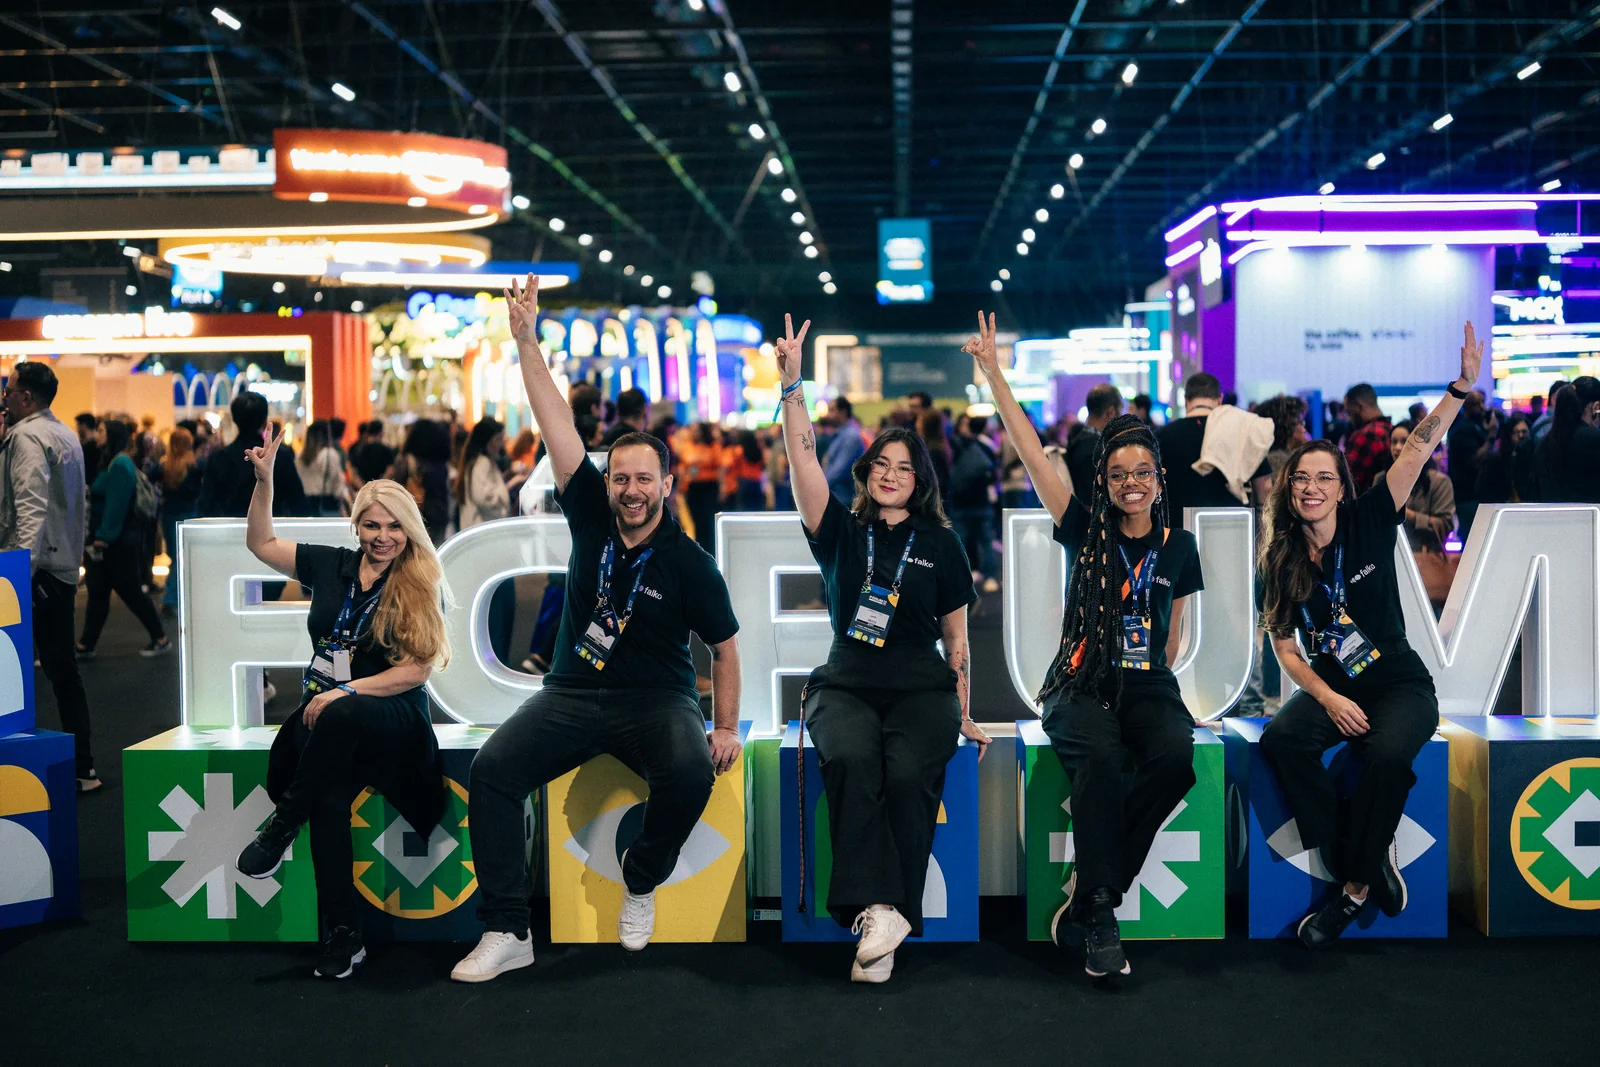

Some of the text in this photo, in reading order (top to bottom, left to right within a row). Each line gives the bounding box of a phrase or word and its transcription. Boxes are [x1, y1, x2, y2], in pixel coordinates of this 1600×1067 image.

[914, 557, 934, 569] falko
[1359, 563, 1376, 578] falko
[1155, 575, 1171, 587] falko
[643, 586, 663, 600] falko
